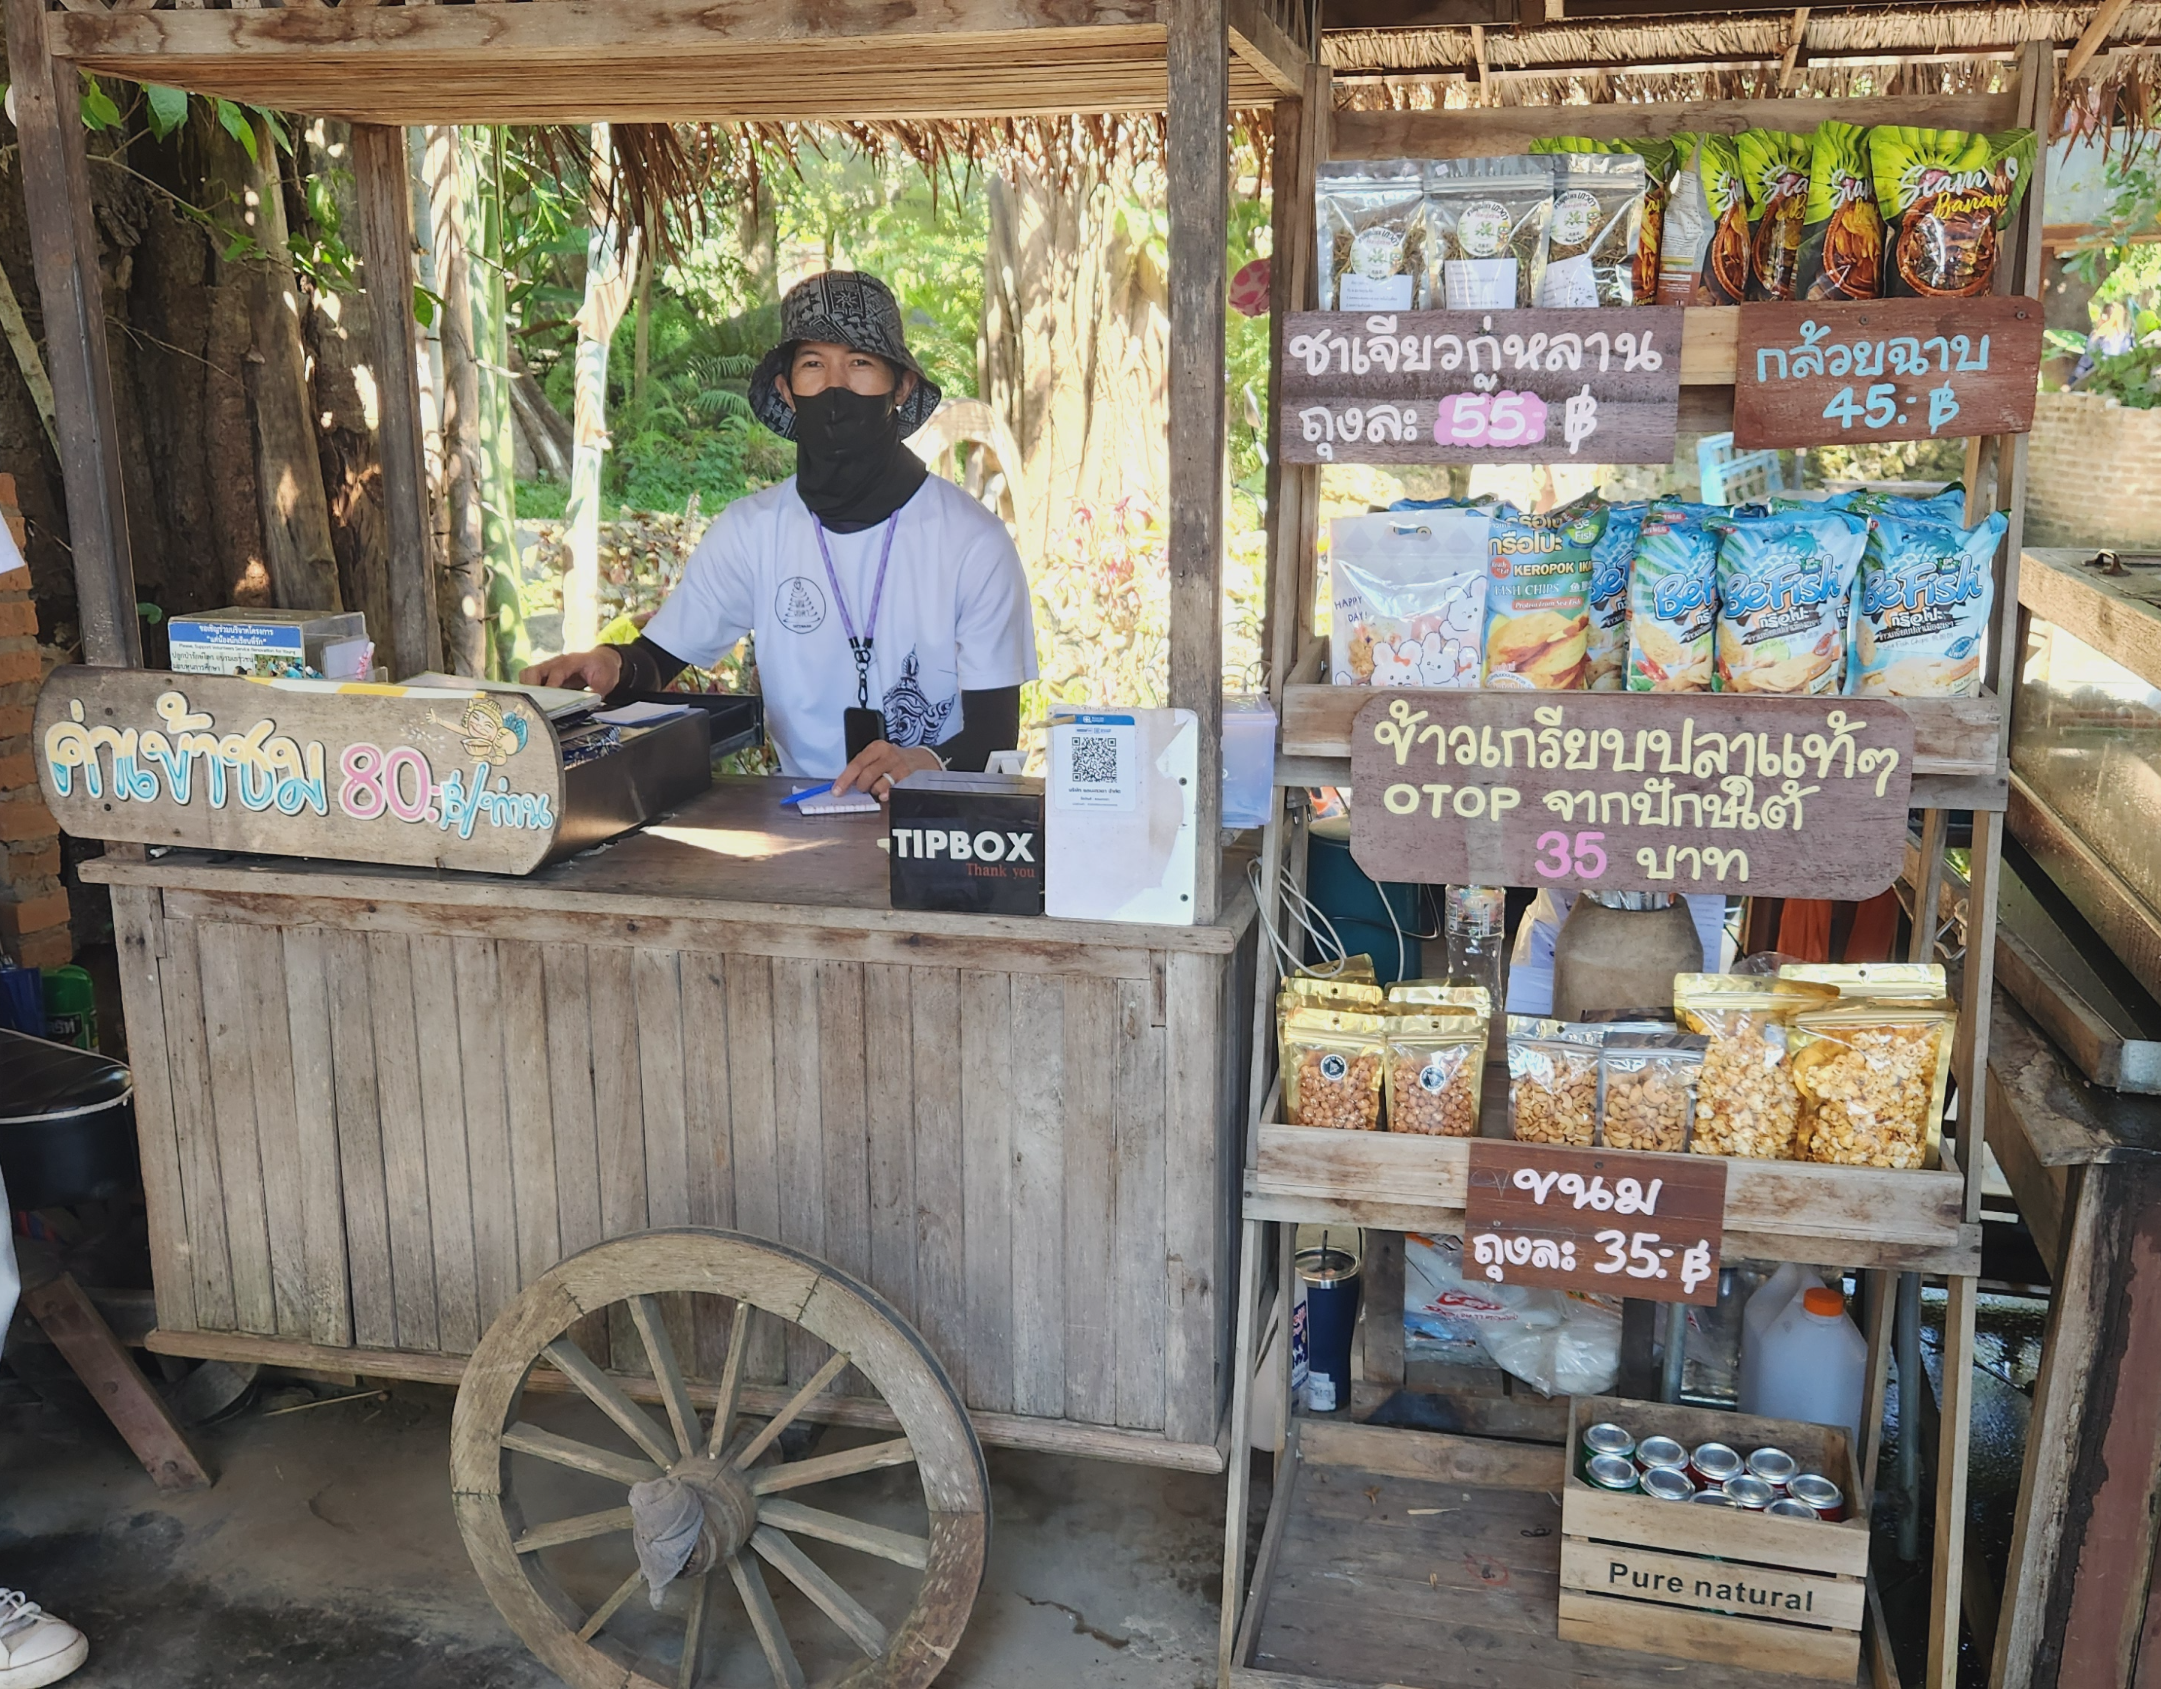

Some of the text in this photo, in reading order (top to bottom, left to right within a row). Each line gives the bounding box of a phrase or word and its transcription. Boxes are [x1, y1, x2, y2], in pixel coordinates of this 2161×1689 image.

[1898, 164, 1987, 210] Siam
[1289, 314, 1662, 391] ชาเจียวกู่หลาน
[1756, 319, 1991, 383] กล้วยฉาบ
[1298, 404, 1418, 461] ถุงละ
[1574, 531, 1594, 541] Fish
[1494, 584, 1560, 596] FISH CHIPS
[1513, 562, 1575, 577] KEROPOK
[1334, 596, 1362, 610] HAPPY
[1348, 611, 1368, 622] DAY!
[45, 691, 329, 816] ค่าเข้าชม
[1374, 699, 1900, 798] ข้าวเกรียบปลาแท้ๆ
[1383, 784, 1521, 822] OTOP
[892, 828, 1035, 863] TIPBOX
[1534, 830, 1749, 882] 35 บาท
[965, 862, 1035, 880] Thank you
[1513, 1168, 1663, 1216] ขนม
[1473, 1233, 1577, 1282] ถุงละ
[1608, 1561, 1814, 1612] Pure natural
